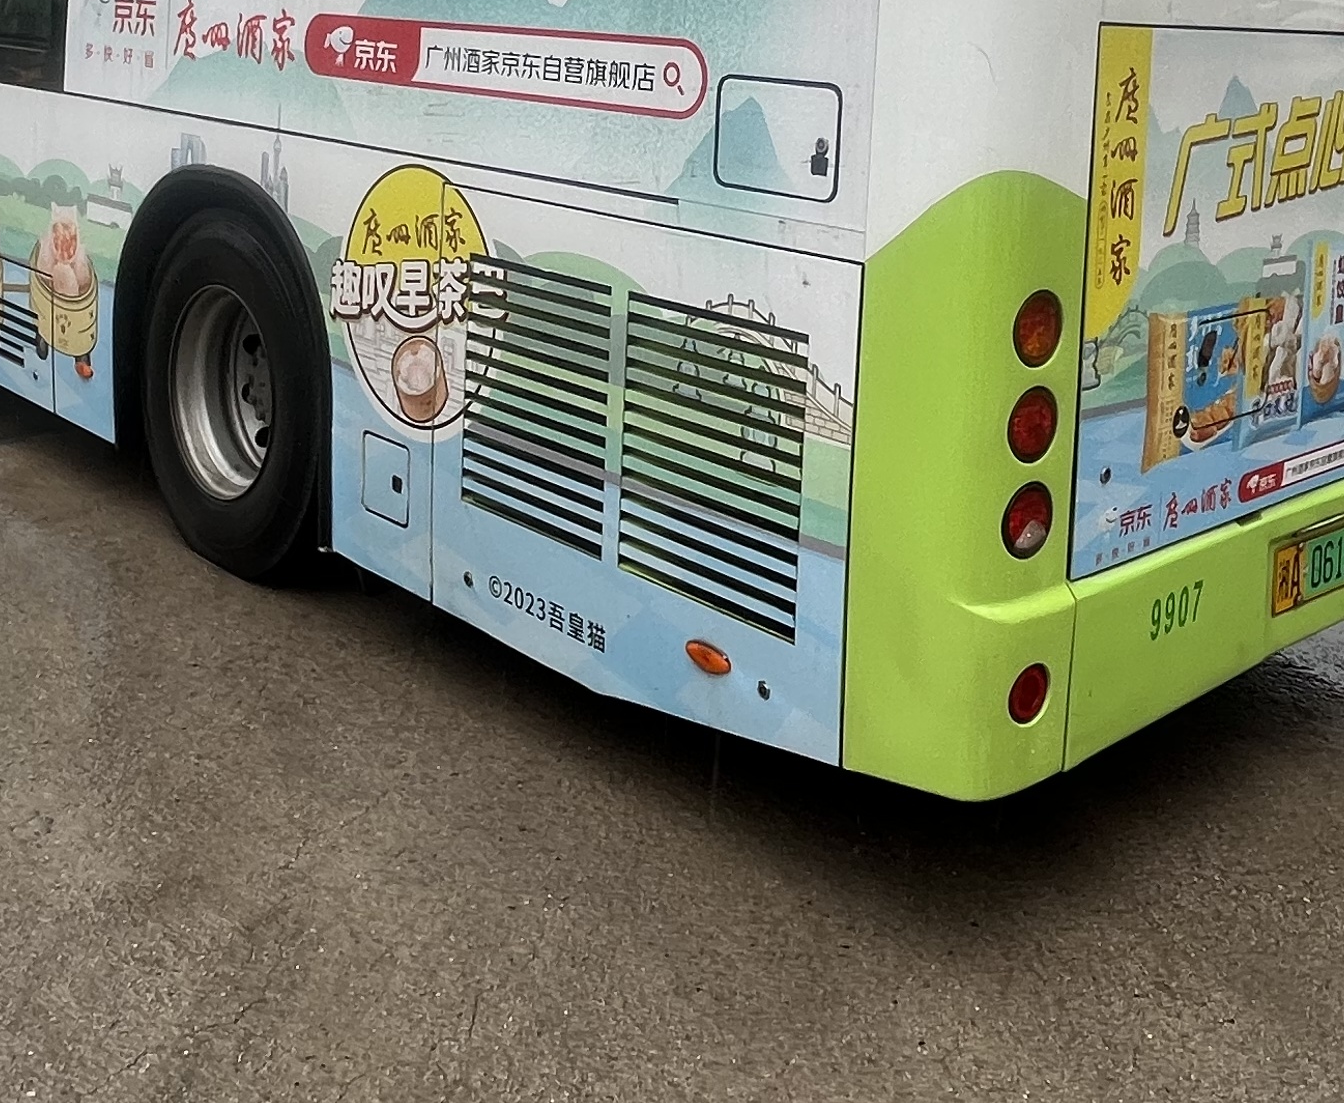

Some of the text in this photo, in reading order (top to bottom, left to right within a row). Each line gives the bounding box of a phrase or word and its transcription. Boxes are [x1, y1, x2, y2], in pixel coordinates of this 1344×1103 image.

[353, 39, 398, 73] 京东
[425, 44, 656, 92] 广州酒家京东自营旗舰店
[1118, 504, 1154, 538] 京东
[1149, 579, 1204, 641] 9907
